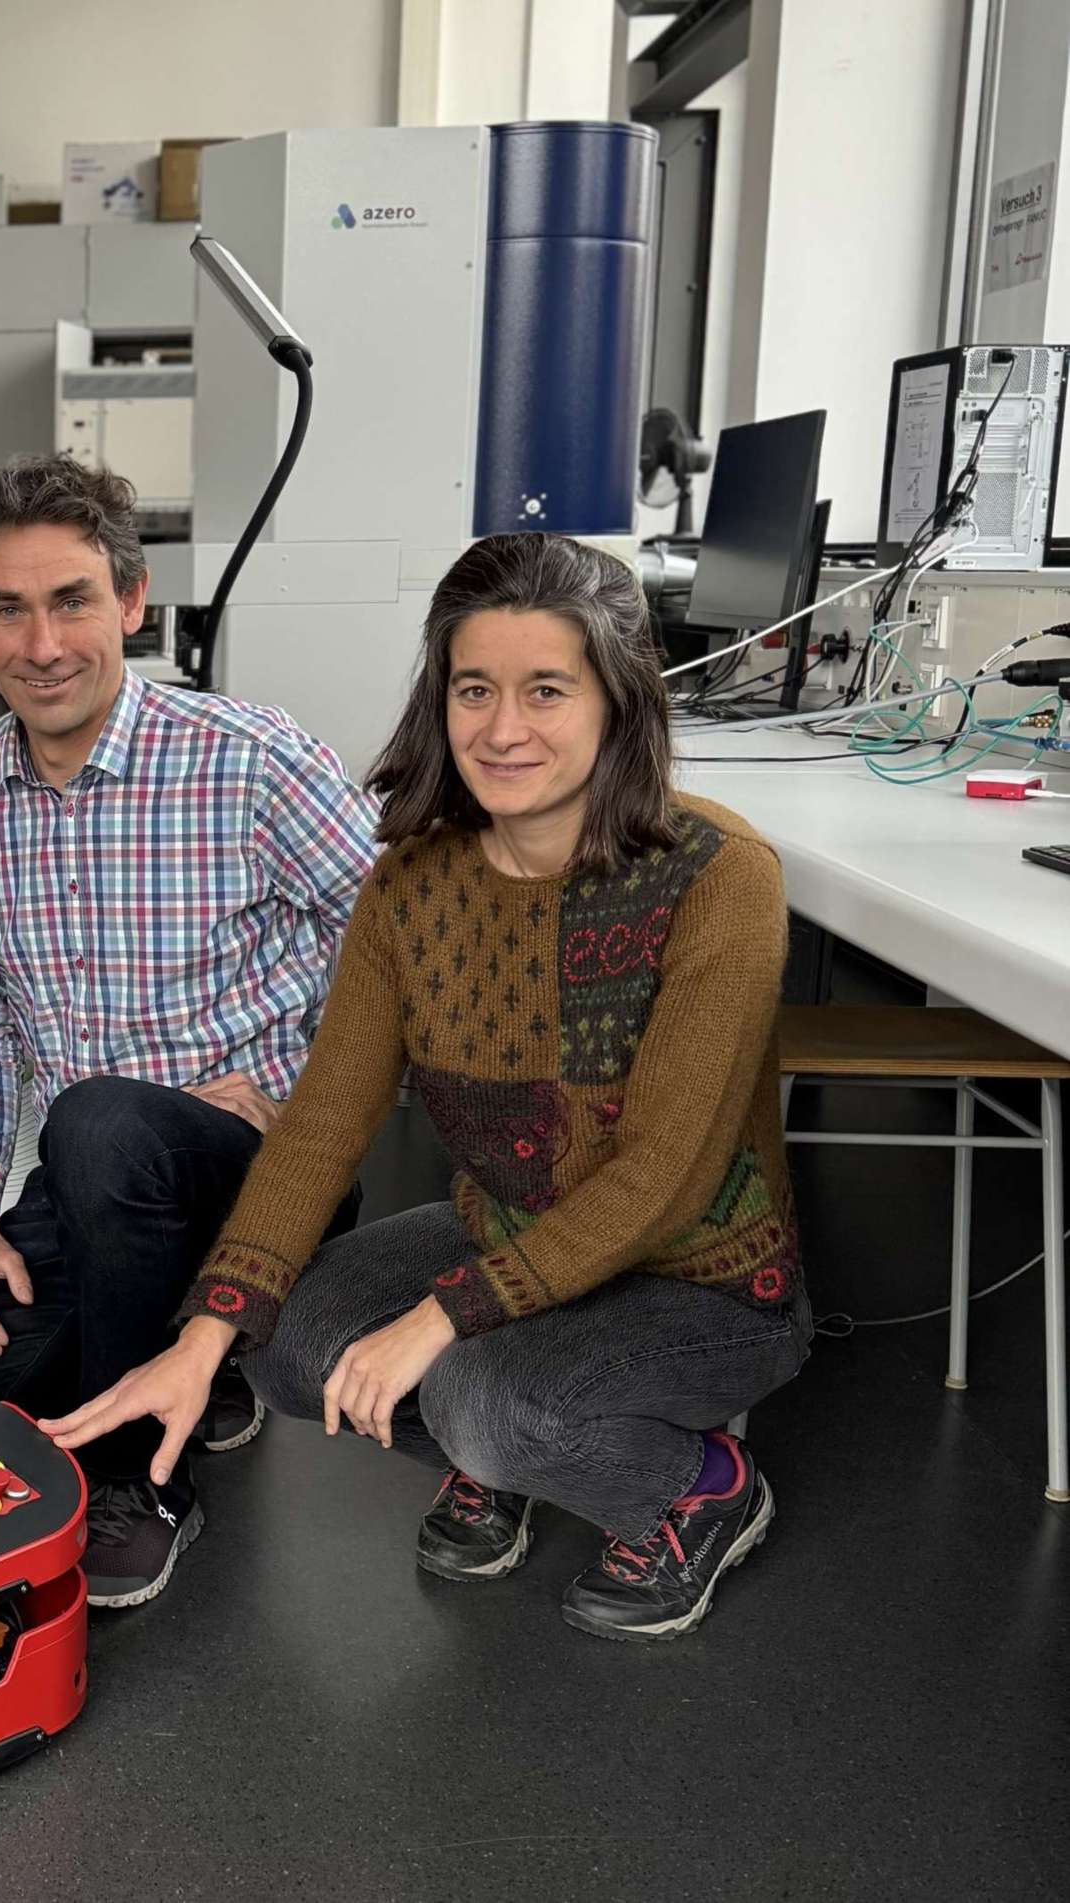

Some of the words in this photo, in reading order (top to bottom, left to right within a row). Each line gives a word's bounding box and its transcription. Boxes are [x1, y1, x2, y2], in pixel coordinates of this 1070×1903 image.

[1001, 187, 1035, 213] Versuch
[1036, 184, 1043, 202] 3
[363, 207, 416, 220] azero
[685, 1520, 723, 1572] Columbia
